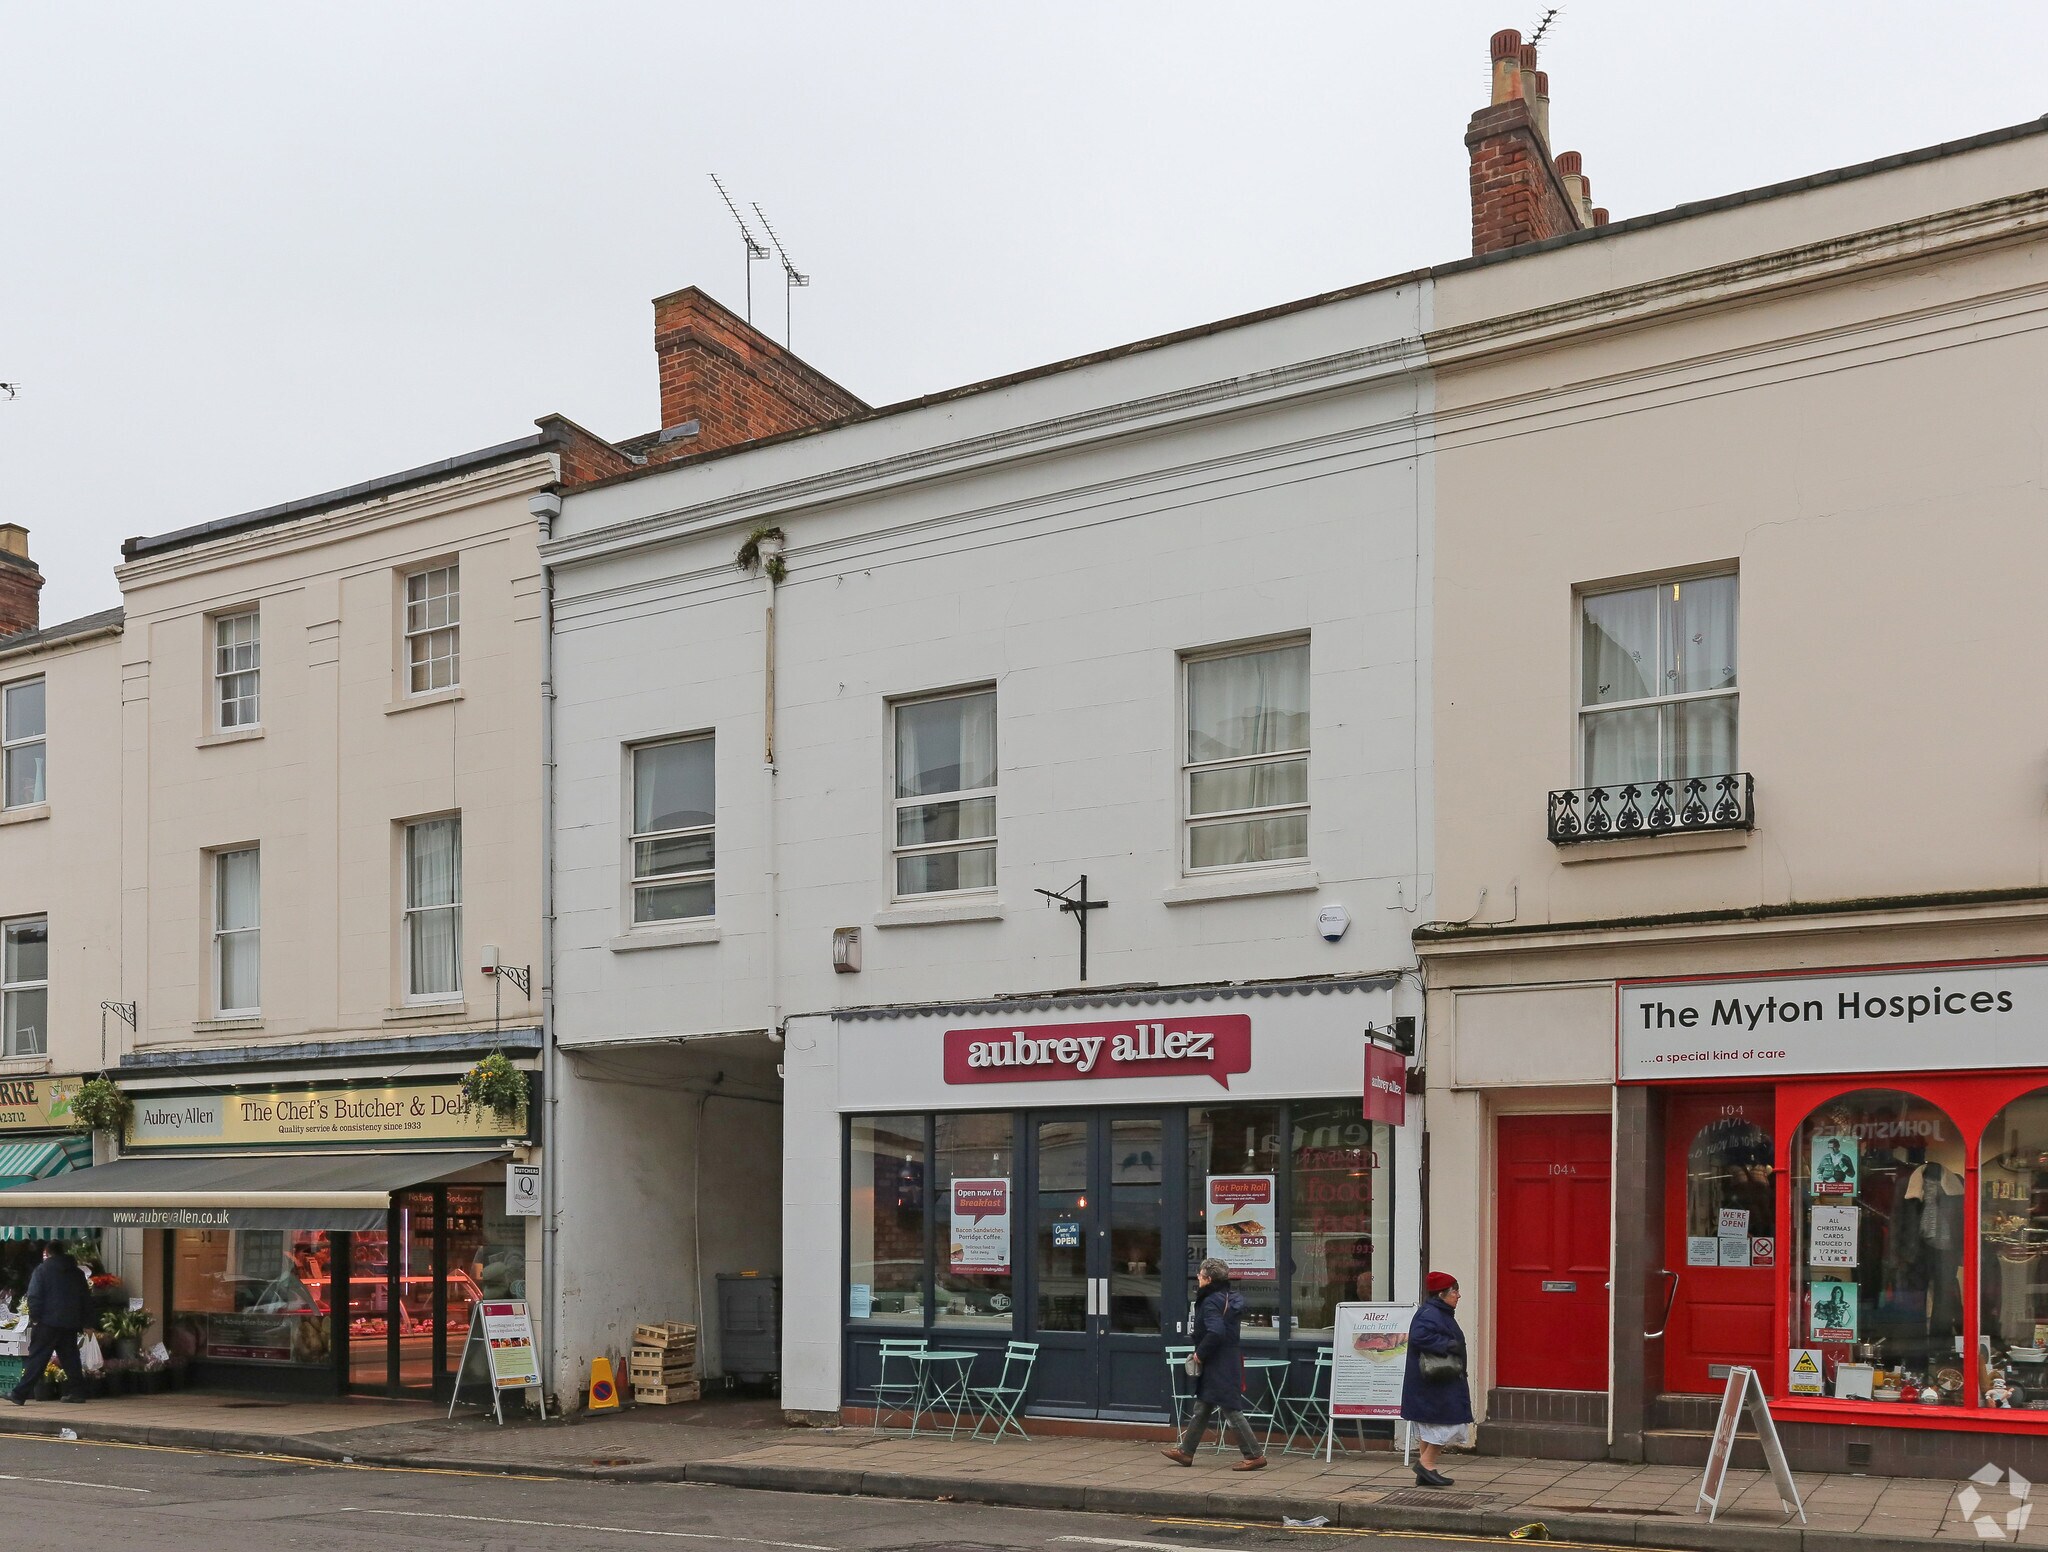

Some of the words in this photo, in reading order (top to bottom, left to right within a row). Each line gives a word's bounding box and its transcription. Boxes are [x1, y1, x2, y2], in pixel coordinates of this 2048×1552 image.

[1640, 1002, 1699, 1029] The
[1711, 996, 1823, 1031] Myton
[1838, 986, 2013, 1024] Hospices
[967, 1031, 1106, 1073] aubrey
[1110, 1023, 1215, 1062] allez
[1665, 1051, 1709, 1064] special
[1713, 1049, 1739, 1061] kind
[1742, 1049, 1754, 1060] of
[1757, 1049, 1786, 1060] care
[1371, 1075, 1390, 1094] aubrey
[1388, 1080, 1402, 1096] allez
[0, 1081, 39, 1106] RKE
[241, 1102, 272, 1122] The
[276, 1099, 328, 1121] Chef's
[334, 1097, 404, 1119] Butcher
[410, 1095, 426, 1116] &
[1721, 1104, 1744, 1116] 104
[143, 1108, 184, 1129] Aubrey
[184, 1107, 214, 1125] Allen
[278, 1123, 305, 1135] Quality
[306, 1124, 330, 1133] service
[332, 1123, 339, 1132] &
[339, 1122, 382, 1134] consistency
[383, 1121, 403, 1131] since
[404, 1121, 422, 1130] 1933
[520, 1176, 534, 1196] Q
[957, 1189, 976, 1198] Open
[993, 1188, 1003, 1197] for
[1214, 1183, 1229, 1192] Hot
[1231, 1183, 1250, 1192] Pork
[1307, 1176, 1375, 1202] food
[959, 1199, 1001, 1207] Breakfast
[113, 1208, 230, 1225] www.aubreyallen.co.uk
[1313, 1208, 1371, 1233] fast
[1722, 1211, 1746, 1220] WE'RE
[1721, 1219, 1746, 1228] OPEN!
[1055, 1236, 1077, 1245] OPEN
[1243, 1237, 1264, 1245] £4.50
[1363, 1312, 1389, 1321] Allez!
[1353, 1322, 1376, 1331] Lunch
[1378, 1322, 1399, 1330] Tariff
